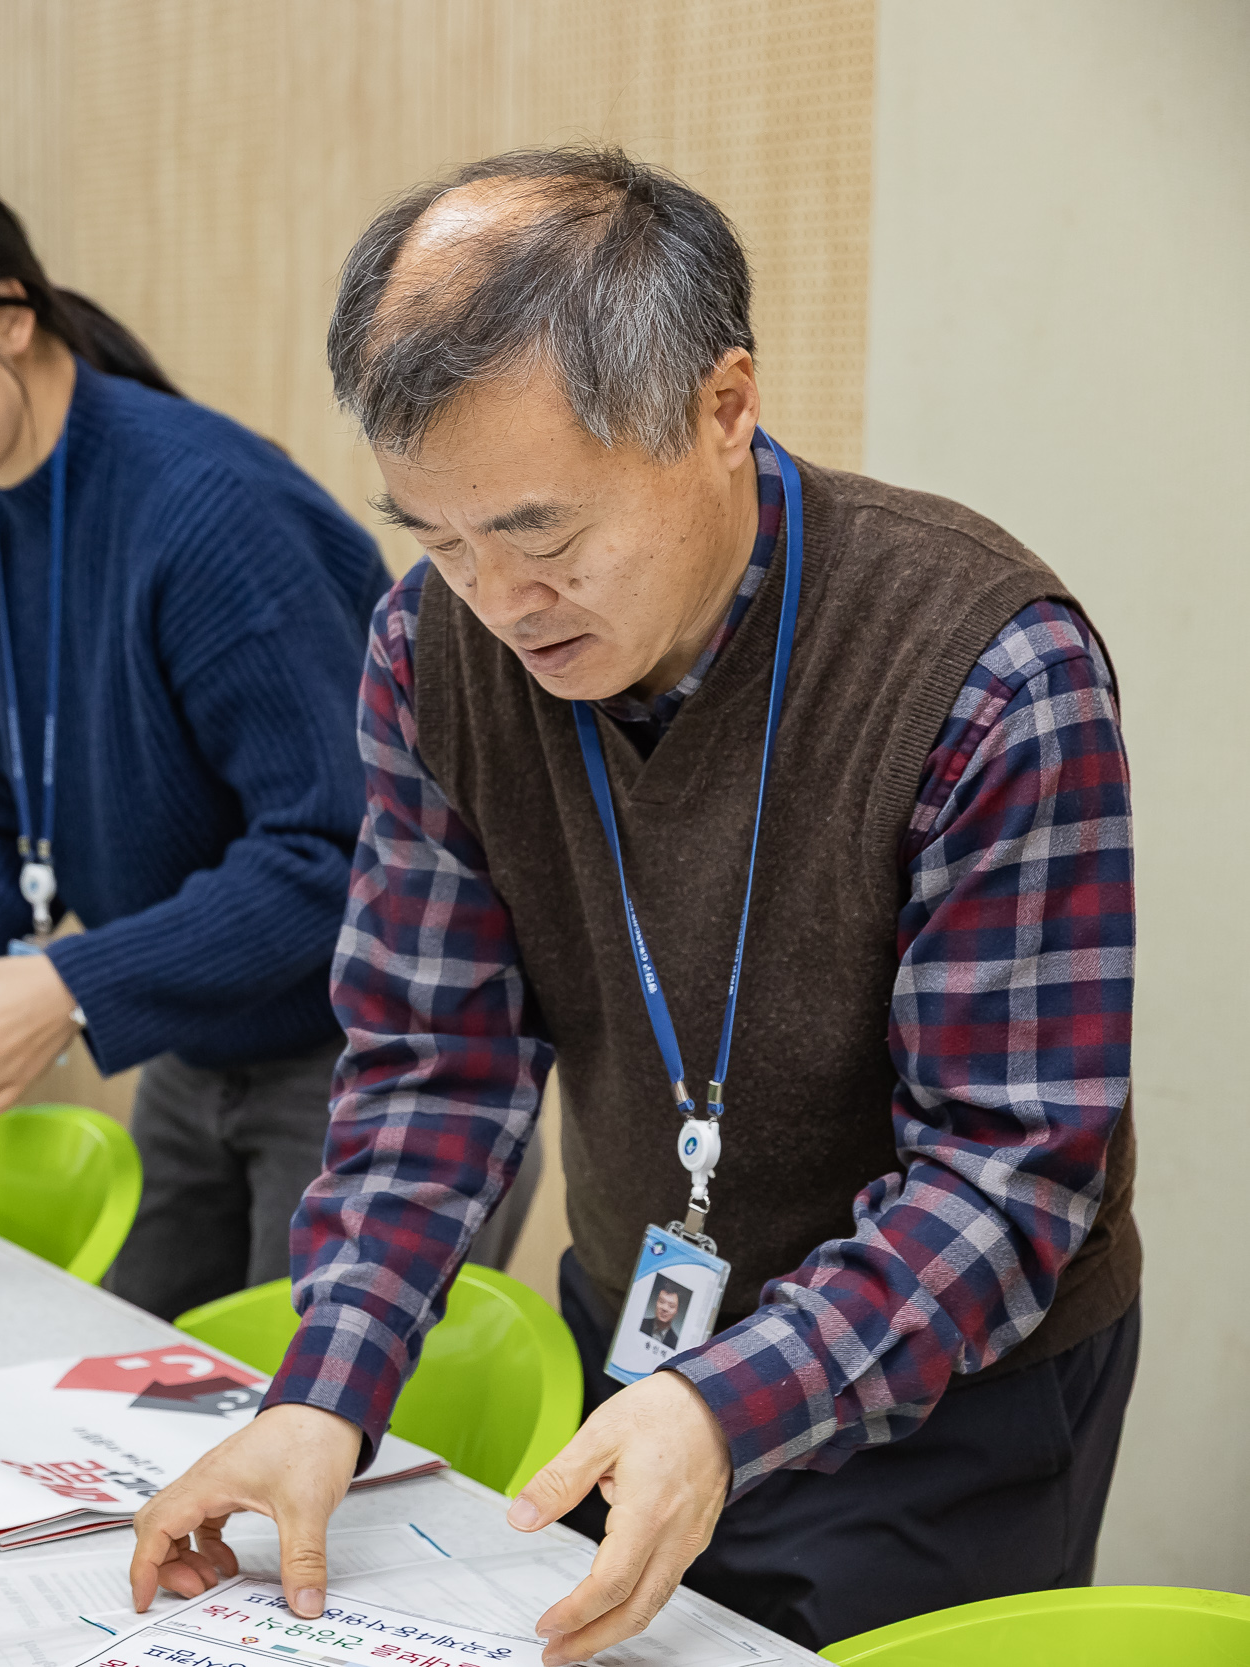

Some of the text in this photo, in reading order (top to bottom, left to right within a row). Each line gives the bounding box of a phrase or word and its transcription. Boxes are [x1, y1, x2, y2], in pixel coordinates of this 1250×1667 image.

[202, 1604, 251, 1623] 나눔
[243, 1592, 513, 1661] 중곡제4동자원봉캠프
[255, 1617, 363, 1650] 건강음식
